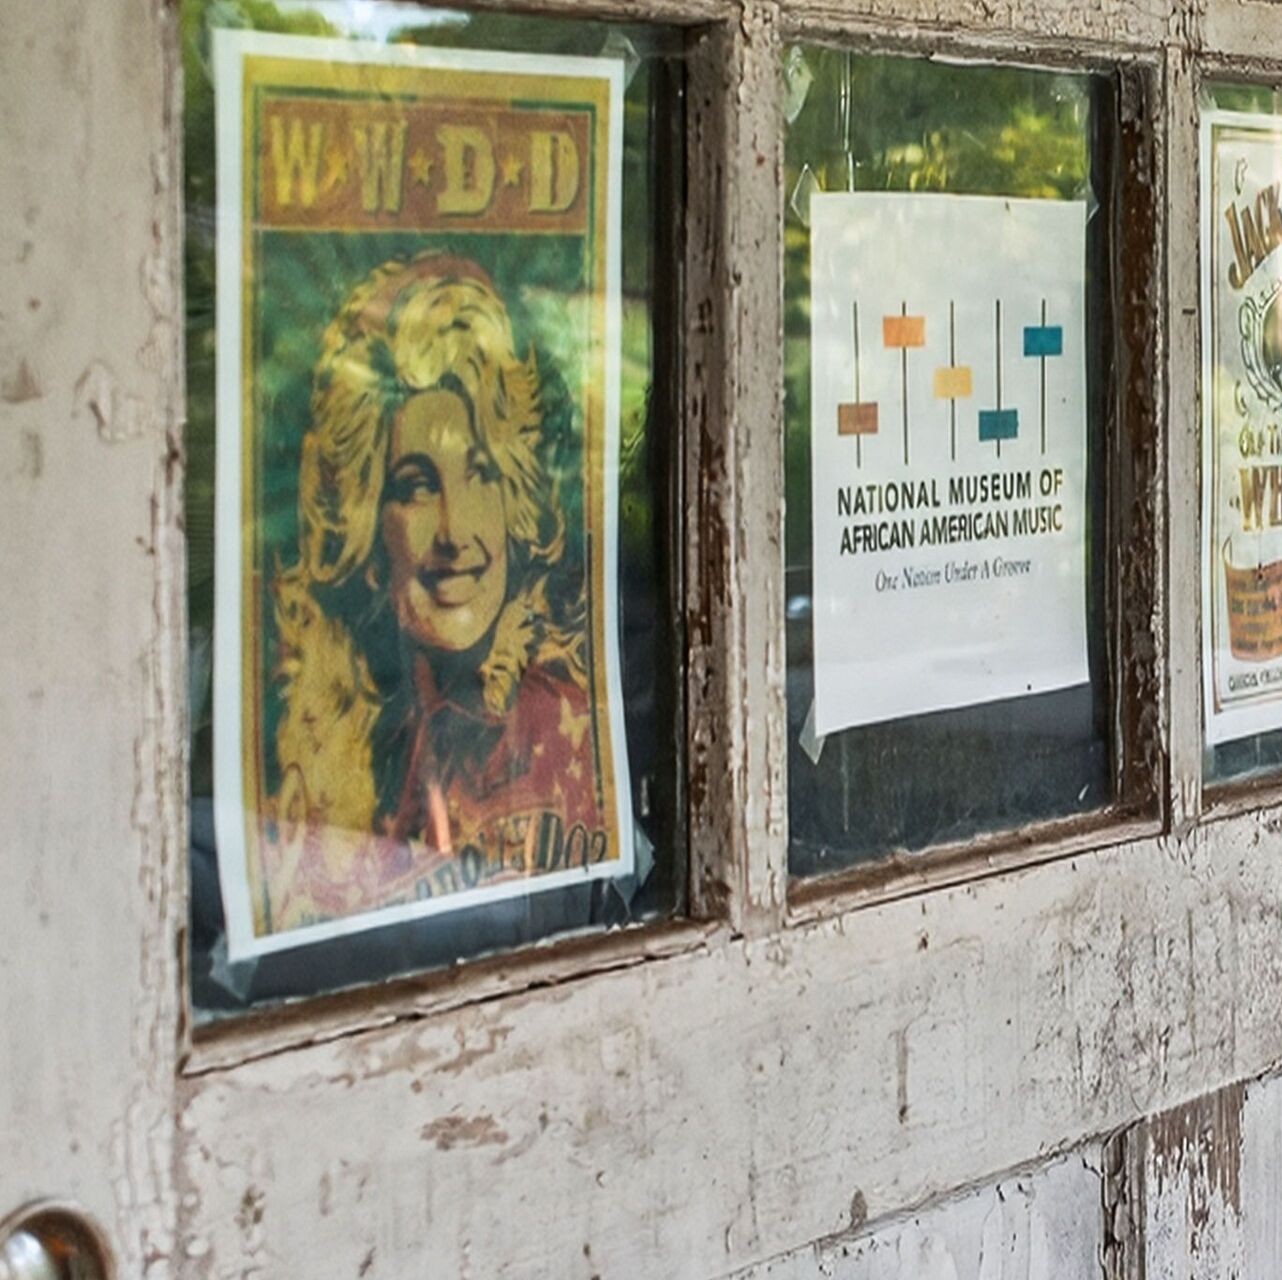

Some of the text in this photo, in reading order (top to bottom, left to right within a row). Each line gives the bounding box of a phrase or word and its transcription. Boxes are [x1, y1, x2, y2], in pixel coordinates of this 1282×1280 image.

[838, 468, 1063, 517] NATIONAL MUSEUM OF
[840, 504, 1063, 556] AFRICAN AMERICAN MUSIC
[875, 570, 898, 593] One
